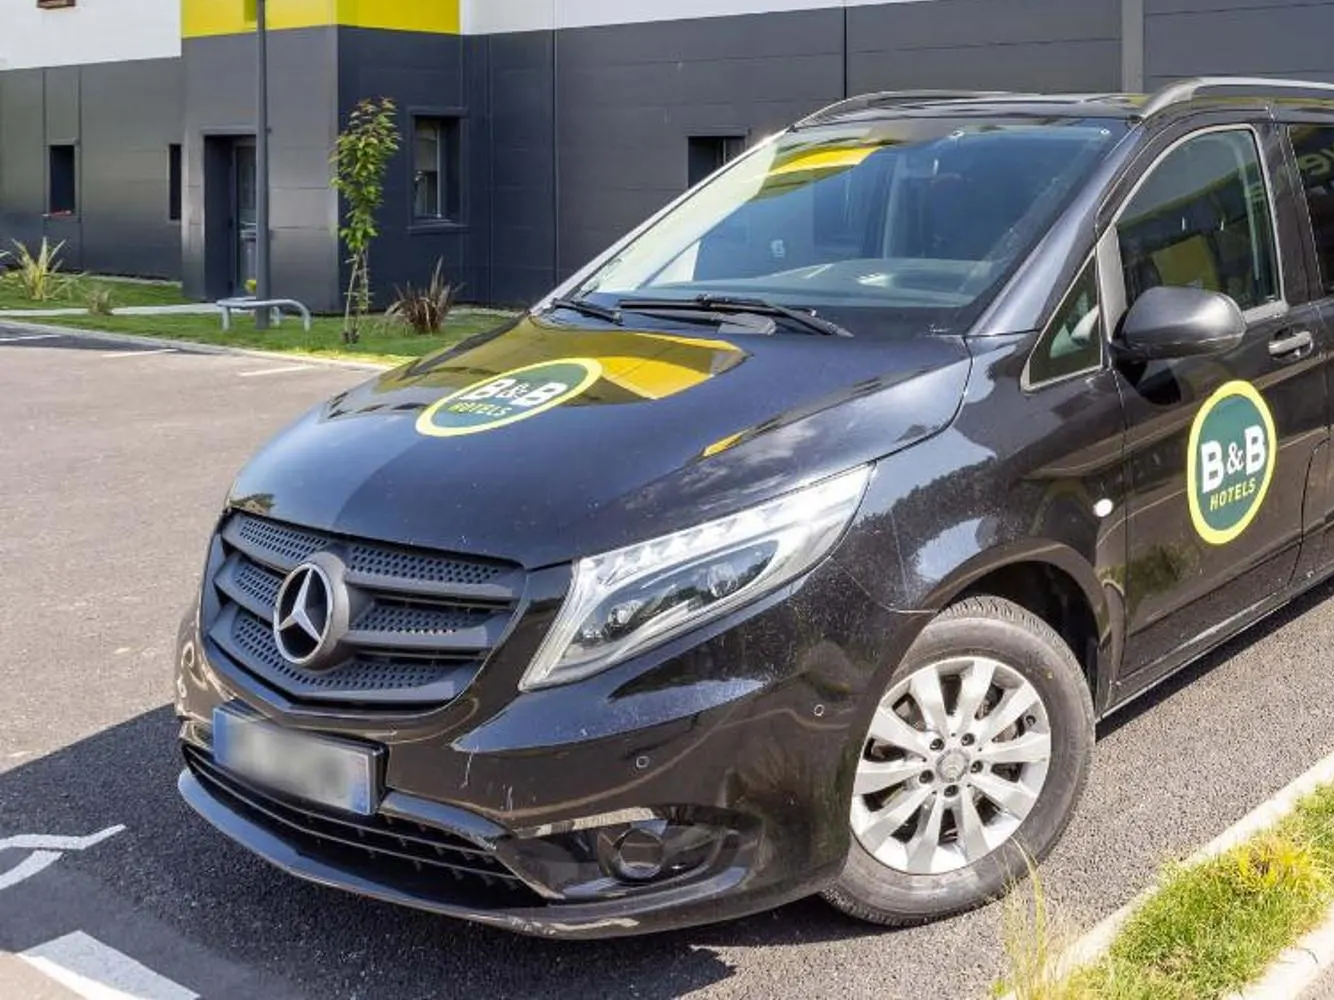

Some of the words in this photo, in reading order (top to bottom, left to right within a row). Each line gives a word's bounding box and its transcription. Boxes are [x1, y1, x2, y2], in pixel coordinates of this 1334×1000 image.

[459, 379, 568, 407] B&B
[1201, 424, 1266, 493] B&B
[1210, 477, 1256, 512] HOTELS
